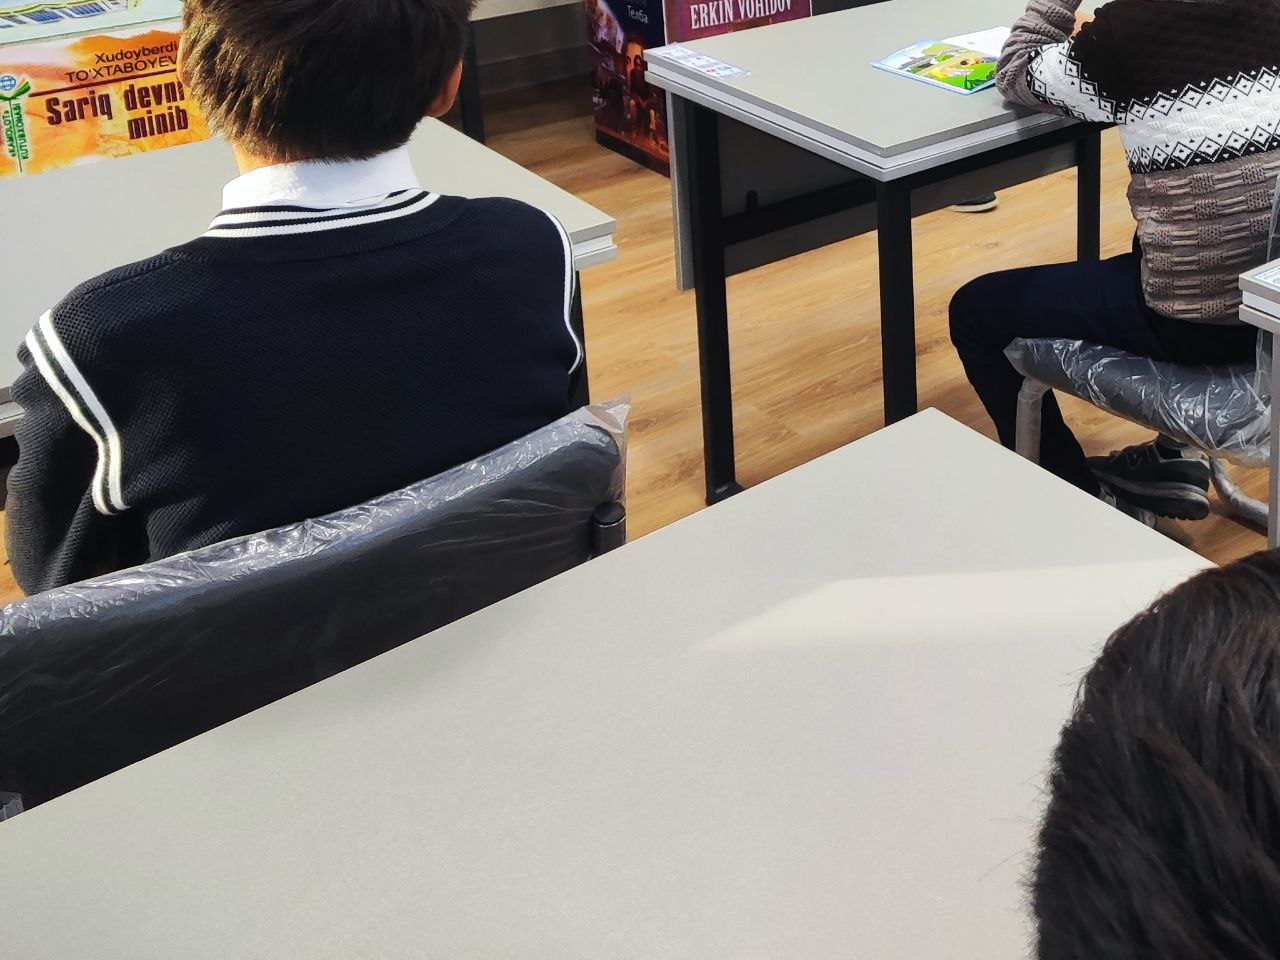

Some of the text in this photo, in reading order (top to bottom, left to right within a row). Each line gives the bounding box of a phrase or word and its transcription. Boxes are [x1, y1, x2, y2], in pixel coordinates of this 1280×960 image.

[627, 5, 648, 24] Телба
[95, 42, 178, 64] Xudoyberdi
[45, 90, 113, 125] Sariq
[127, 105, 189, 140] minib
